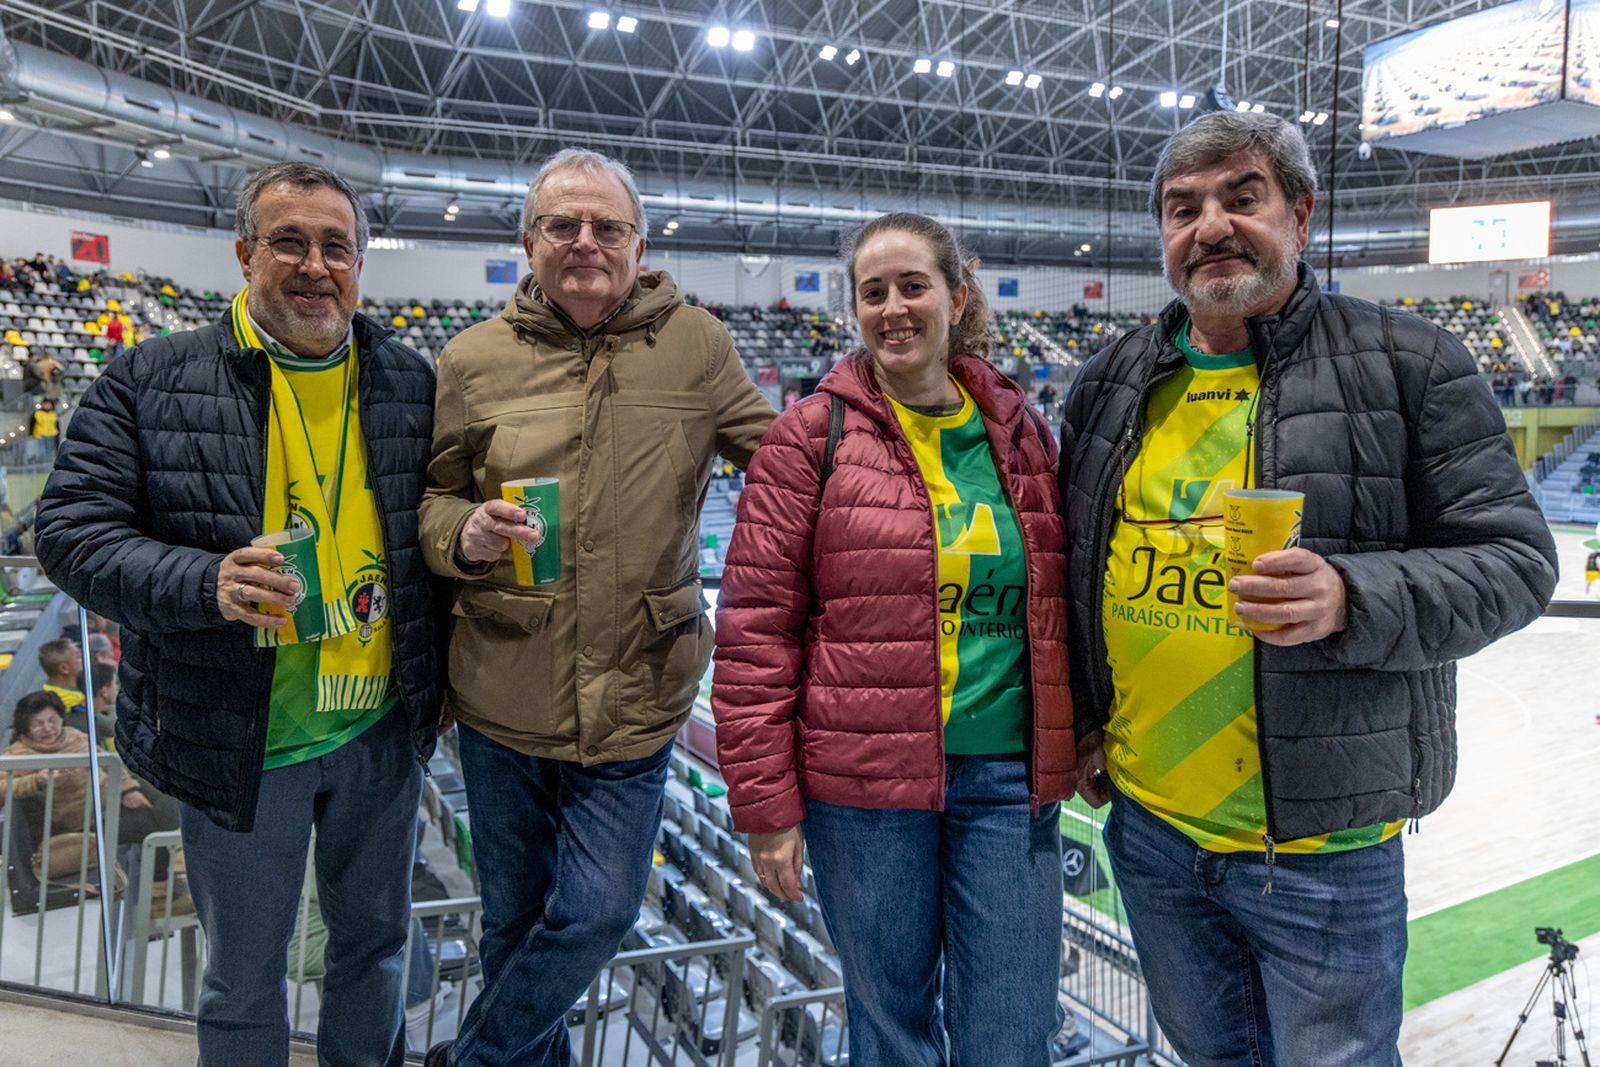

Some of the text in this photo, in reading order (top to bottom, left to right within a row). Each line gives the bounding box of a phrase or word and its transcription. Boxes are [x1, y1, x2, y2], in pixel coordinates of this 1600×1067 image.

[938, 569, 1025, 617] aén
[1127, 546, 1225, 610] Jaé
[959, 621, 1025, 640] INTERIO
[1112, 602, 1180, 629] PARAÍSO
